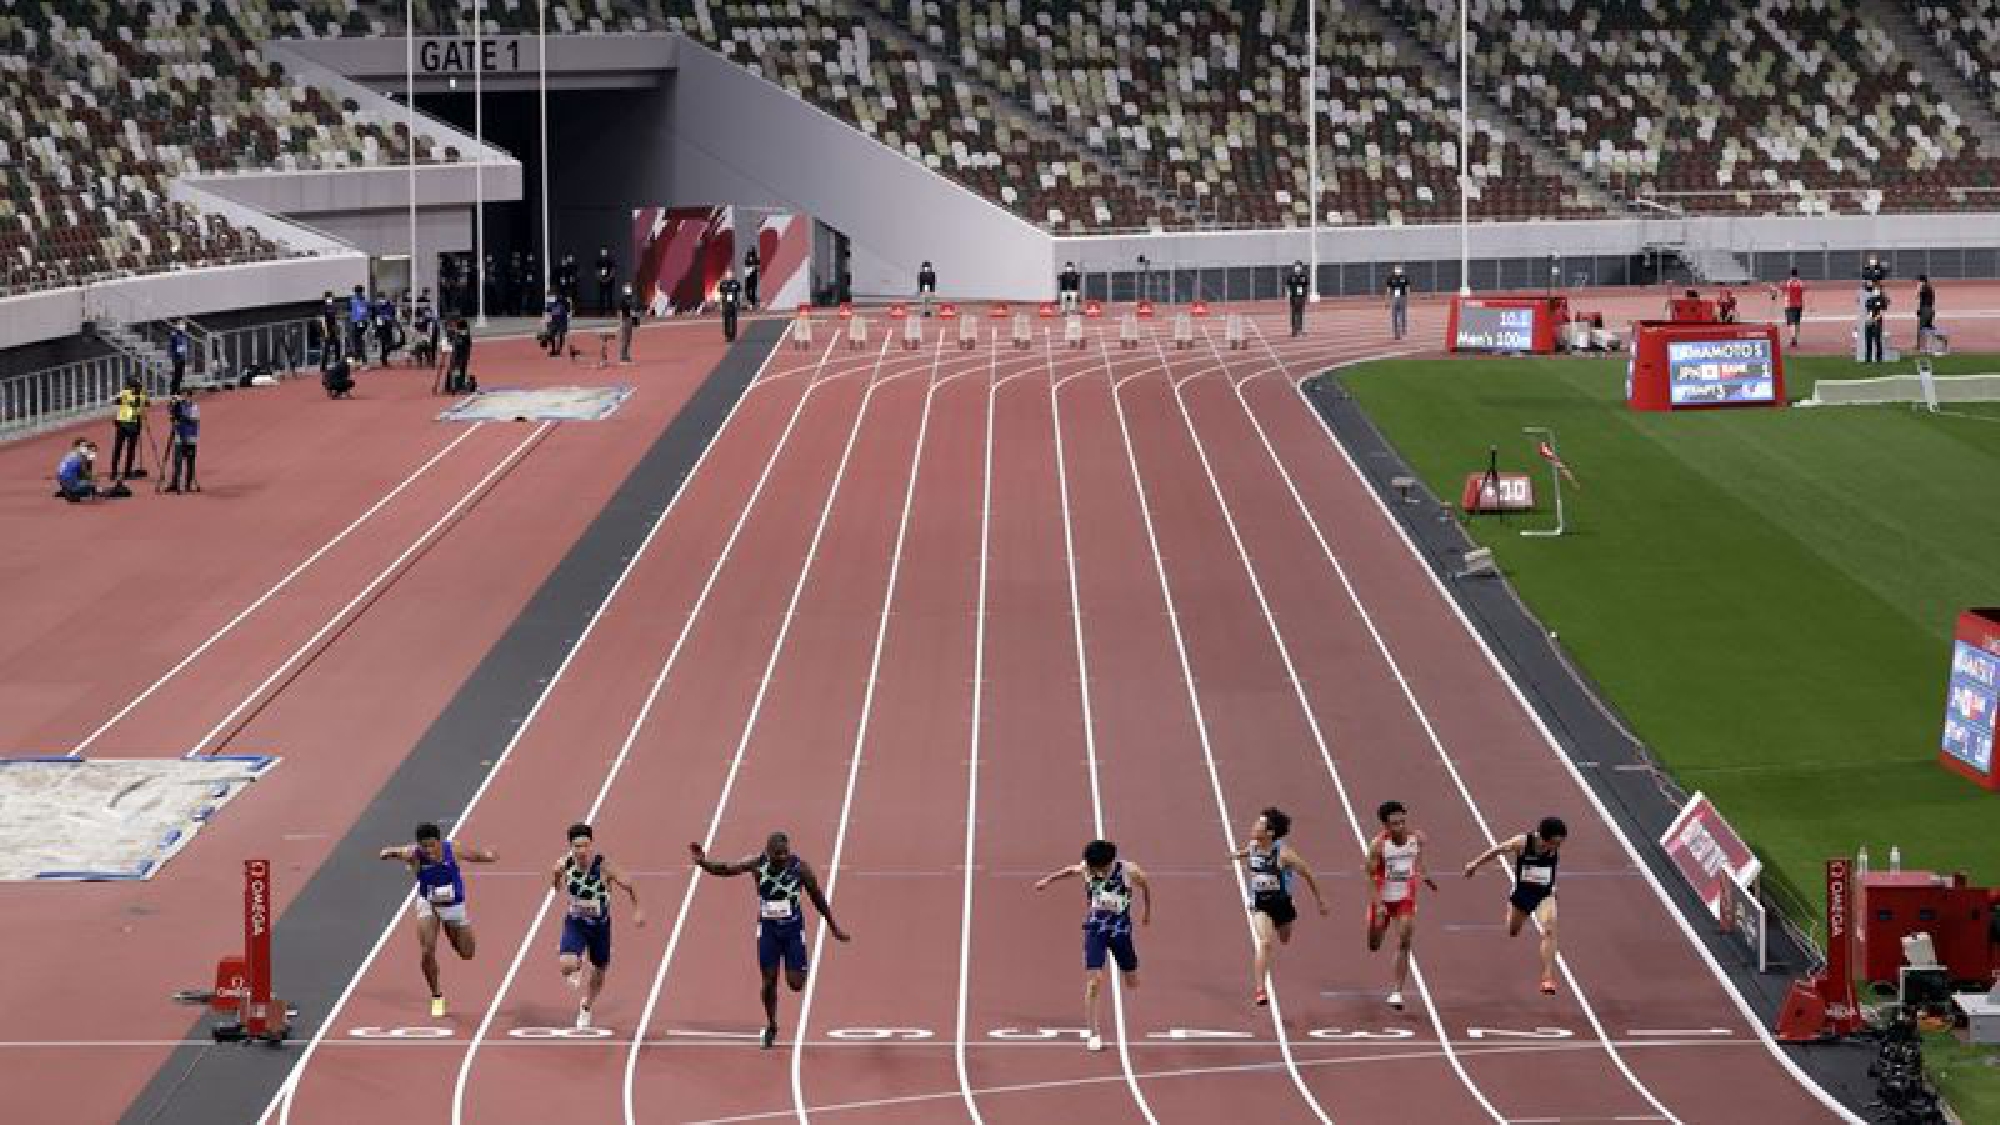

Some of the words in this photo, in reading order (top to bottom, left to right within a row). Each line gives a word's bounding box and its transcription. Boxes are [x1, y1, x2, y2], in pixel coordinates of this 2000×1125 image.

[421, 40, 498, 70] GATE
[507, 40, 518, 70] 1
[251, 880, 265, 936] OMEGA
[1829, 880, 1843, 938] OMEGA
